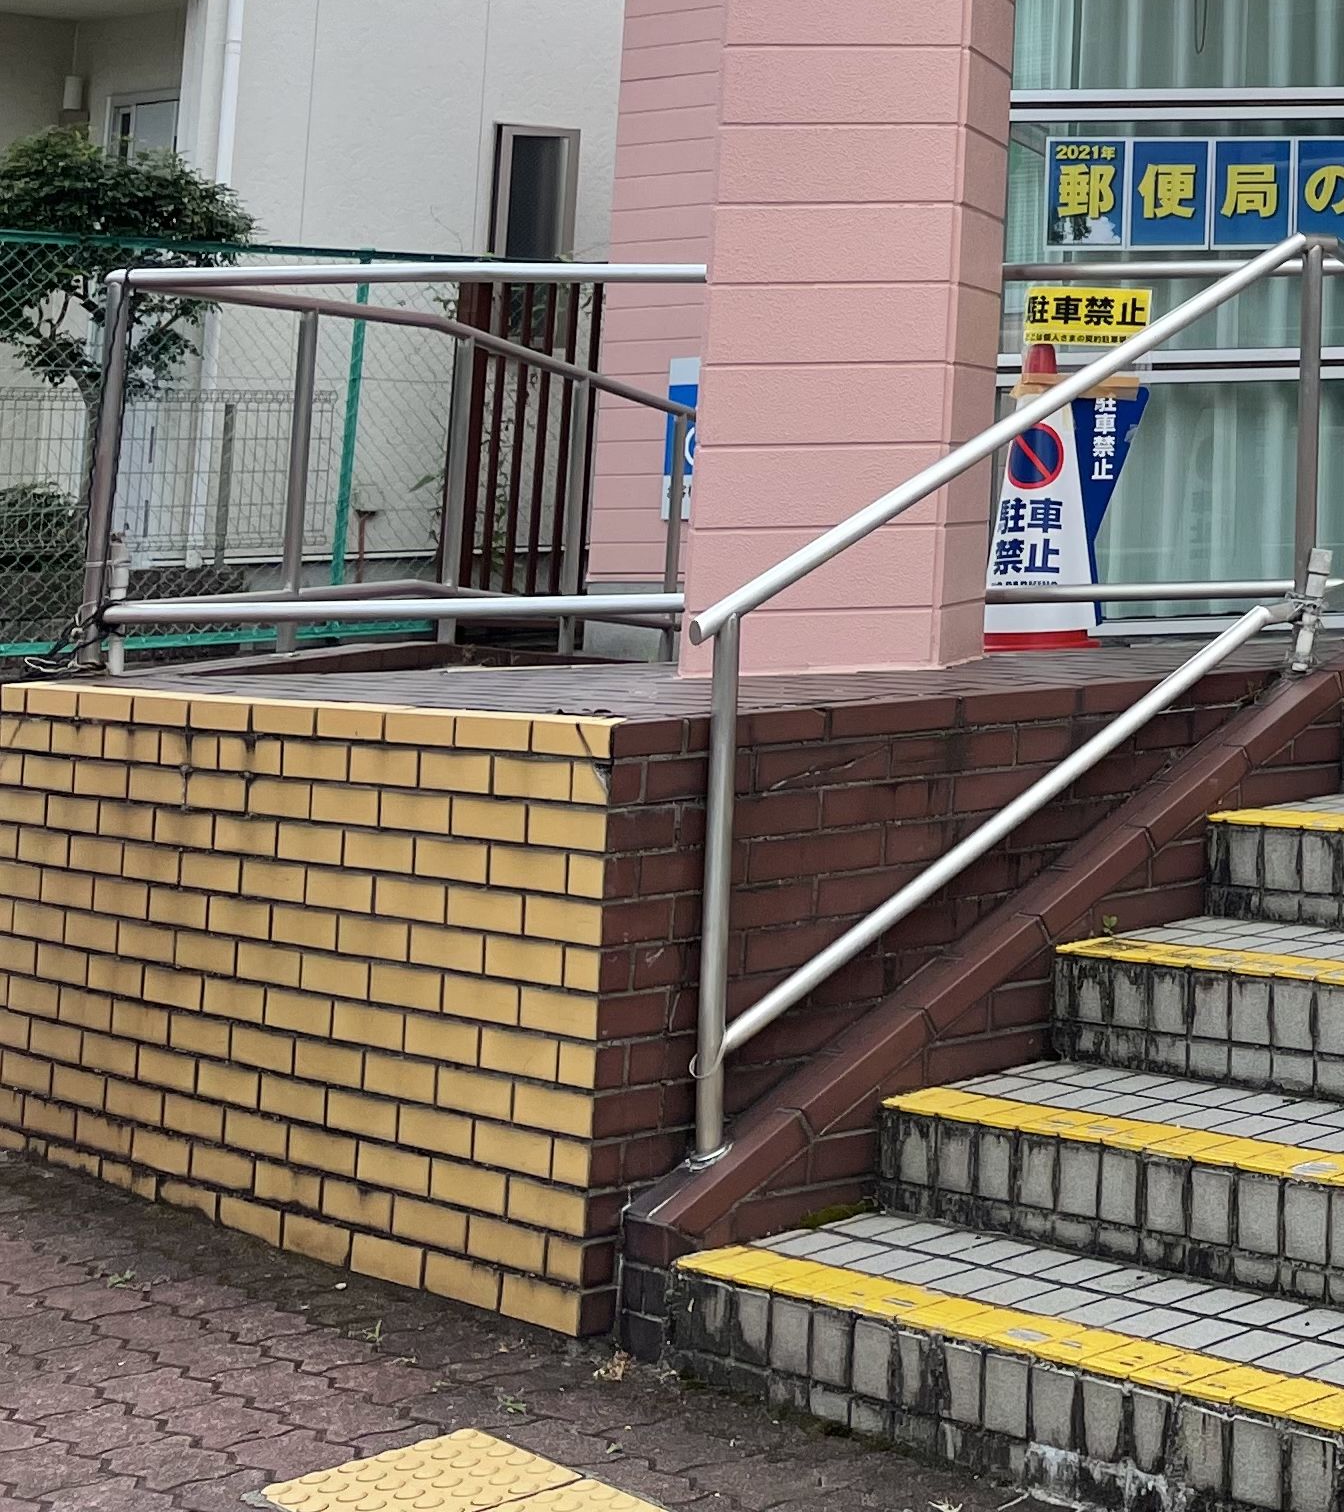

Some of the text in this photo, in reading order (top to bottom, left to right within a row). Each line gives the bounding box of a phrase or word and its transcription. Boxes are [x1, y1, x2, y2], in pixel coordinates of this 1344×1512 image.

[1056, 146, 1116, 160] 2021年
[1027, 296, 1147, 327] 駐車禁止
[1091, 397, 1117, 480] 駐車禁止
[998, 498, 1063, 534] 駐車
[993, 538, 1061, 575] 禁止
